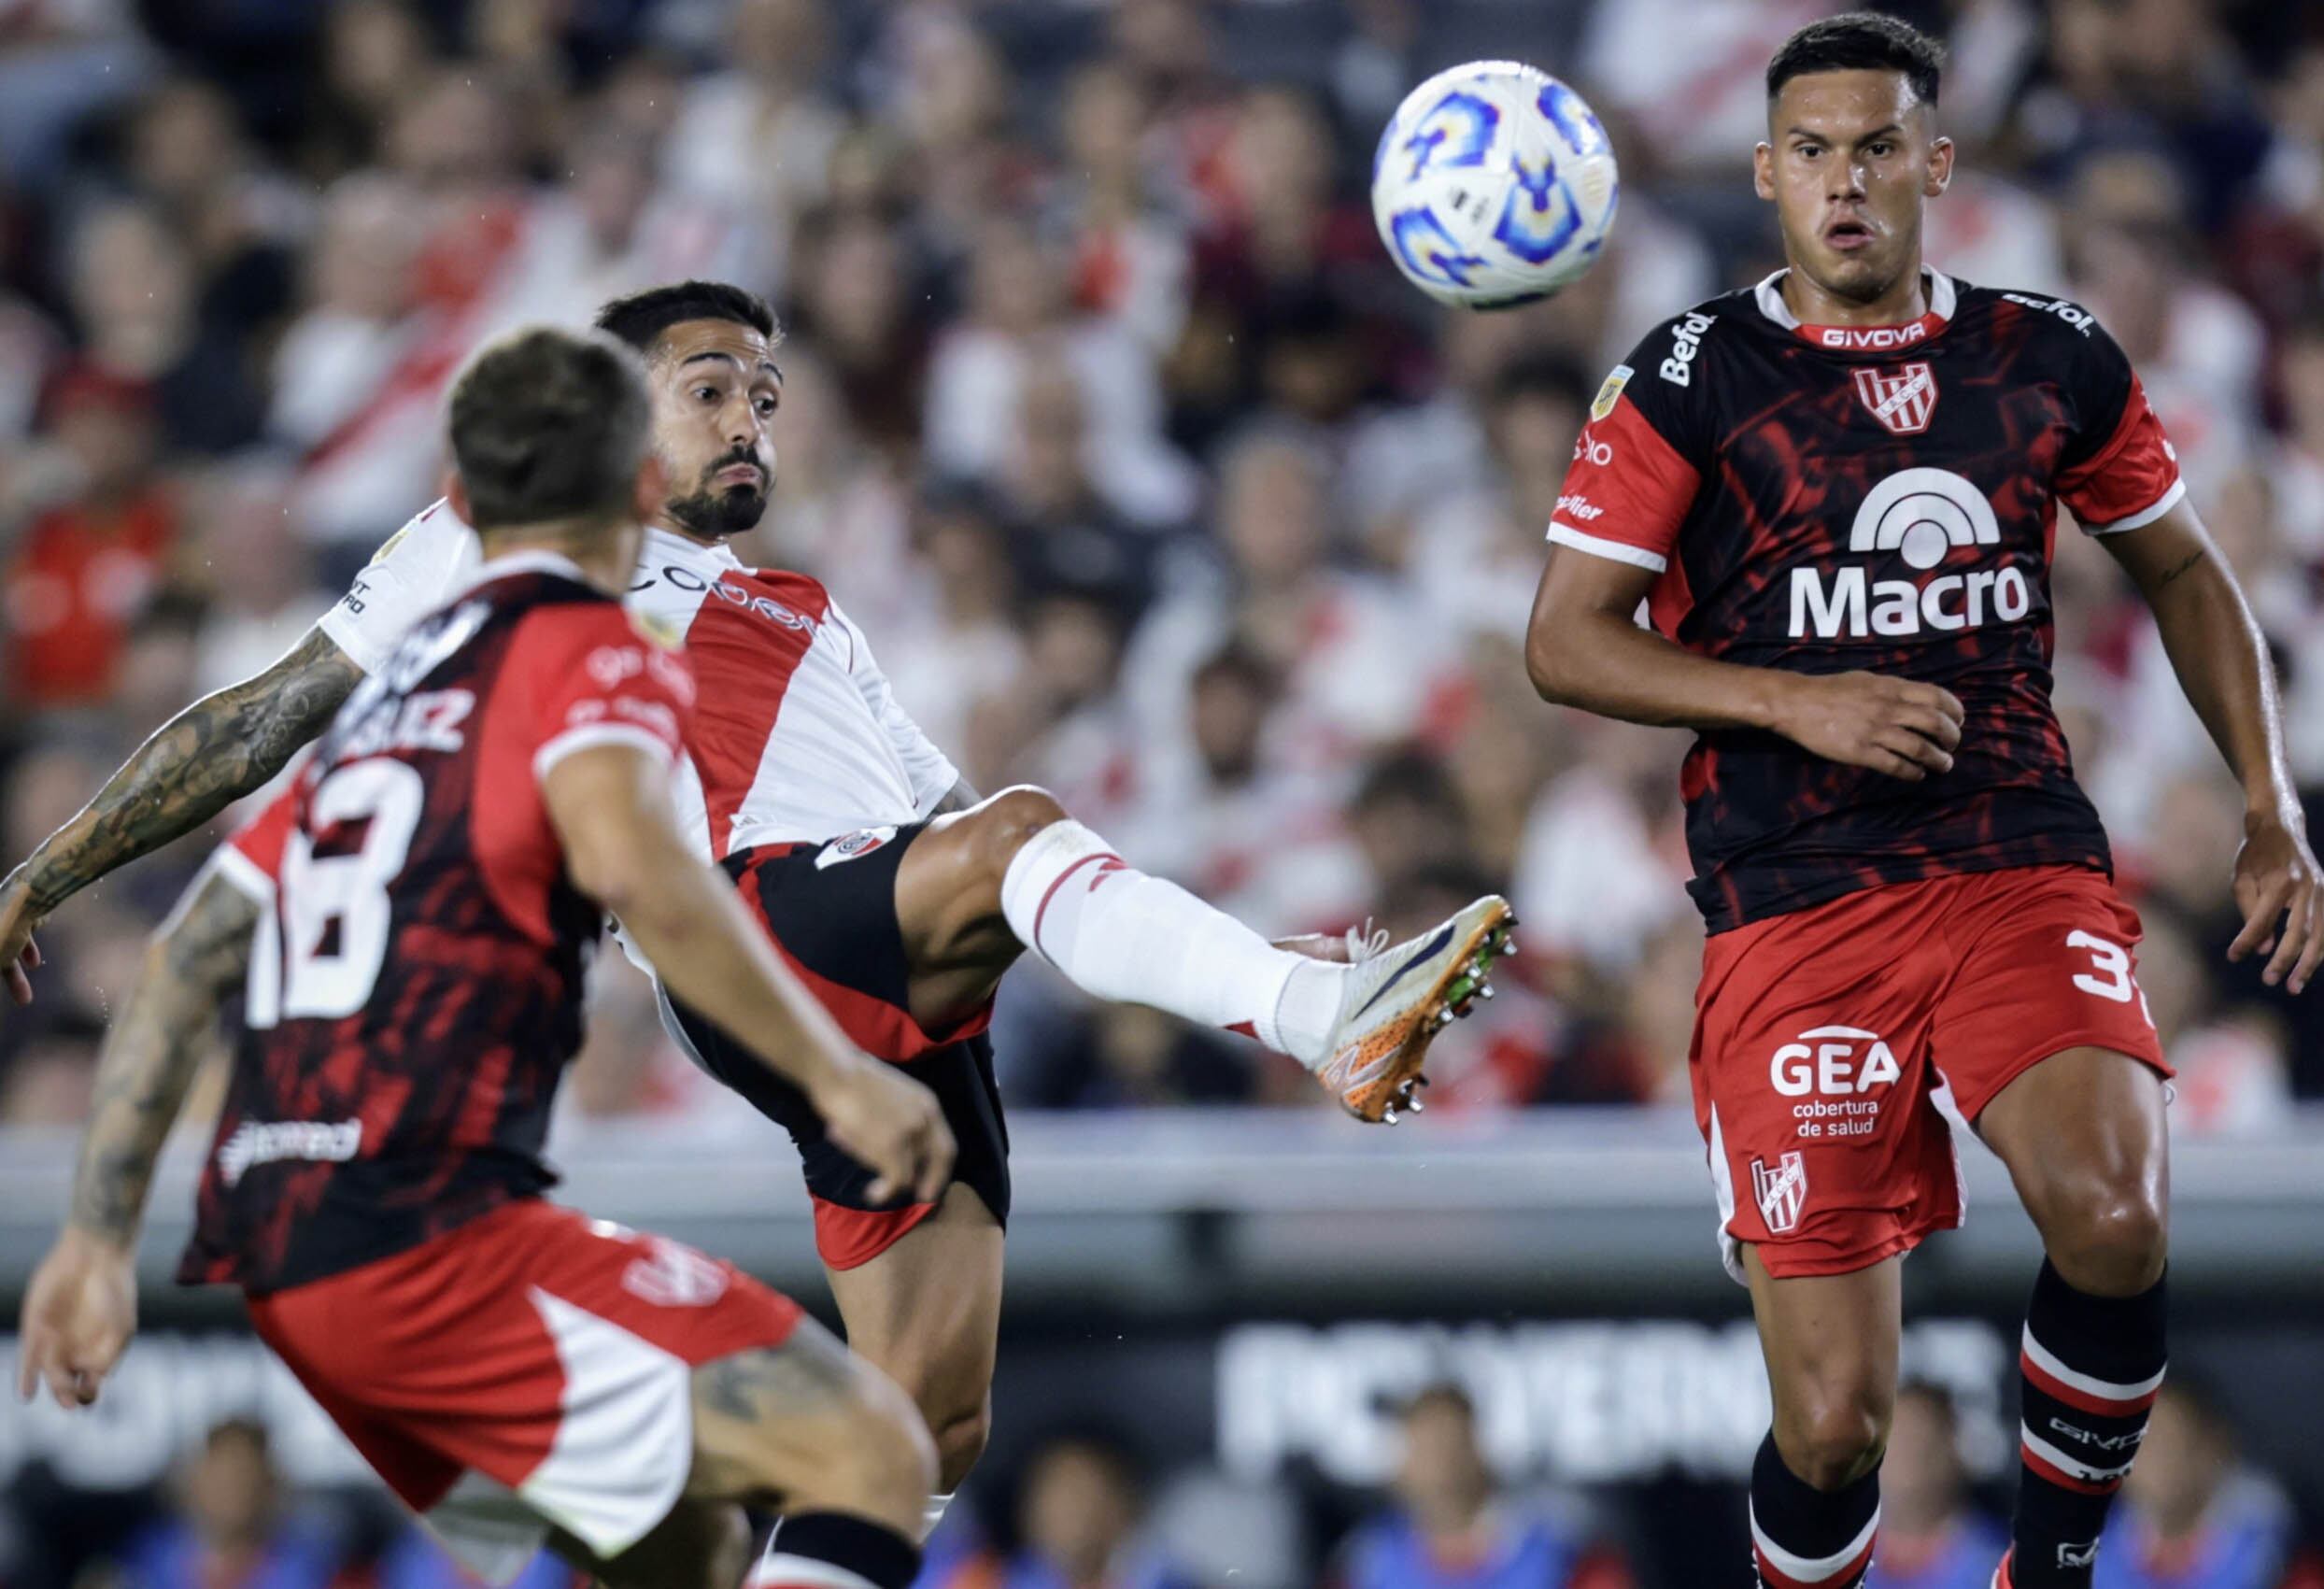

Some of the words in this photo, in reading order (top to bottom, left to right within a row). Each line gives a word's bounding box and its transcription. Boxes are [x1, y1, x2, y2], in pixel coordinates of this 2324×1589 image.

[1822, 323, 1925, 348] GIVOVA
[1788, 565, 2029, 638] Macro
[246, 757, 425, 1029] 18
[2066, 929, 2156, 1029] 3
[1770, 1041, 1901, 1096] GEA
[1793, 1100, 1878, 1117] cobertura
[1797, 1120, 1821, 1137] de
[1827, 1117, 1874, 1136] salud
